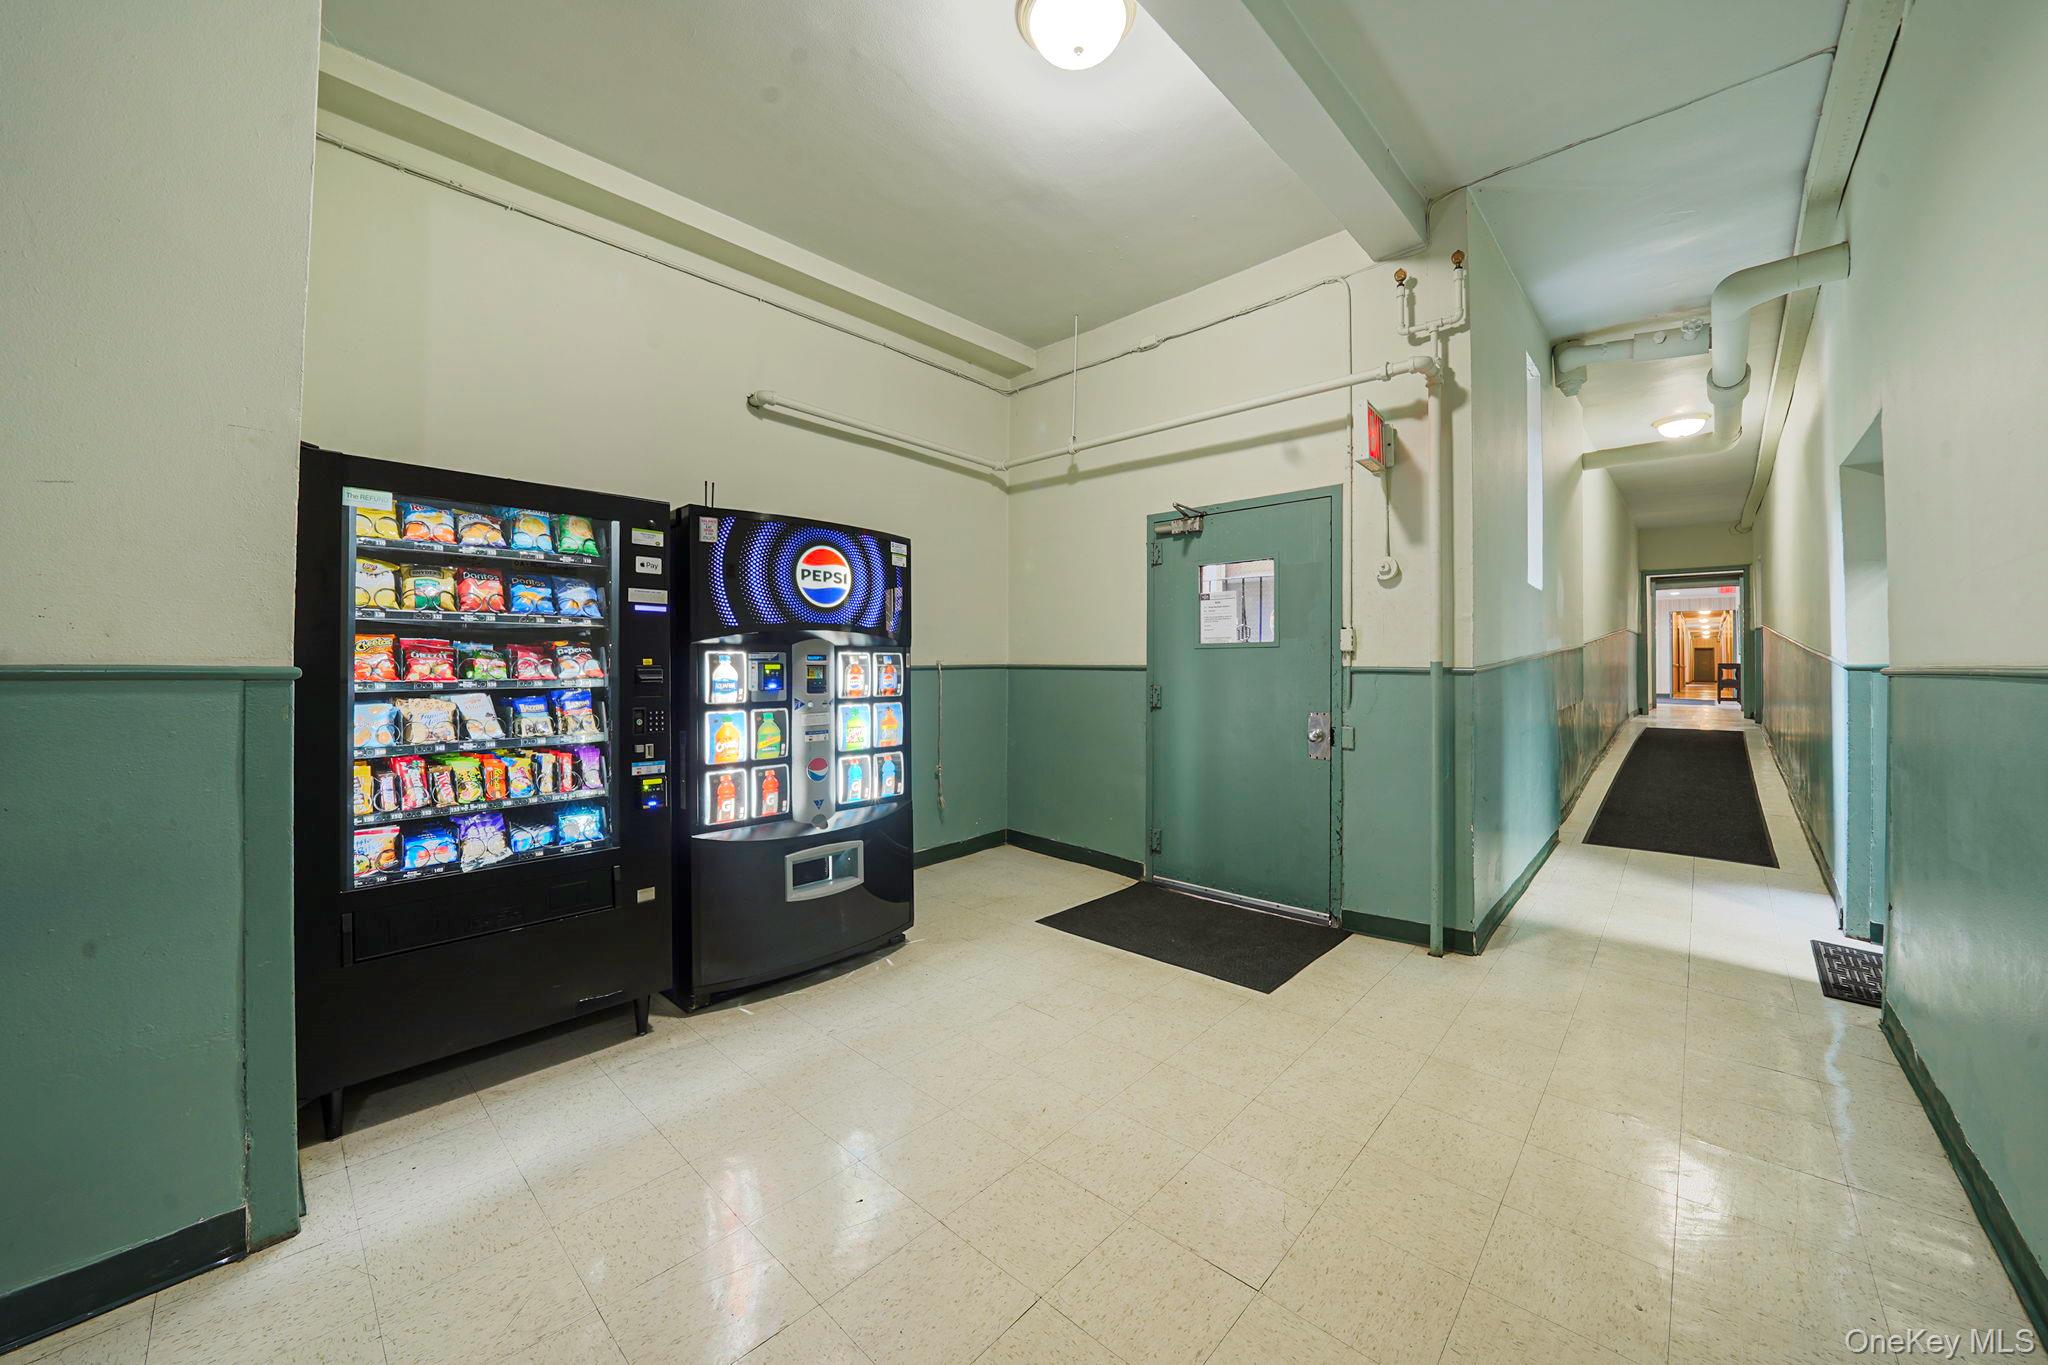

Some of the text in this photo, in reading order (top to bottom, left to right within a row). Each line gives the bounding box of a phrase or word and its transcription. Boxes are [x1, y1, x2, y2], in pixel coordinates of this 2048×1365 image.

[346, 492, 359, 500] The
[646, 562, 659, 570] Pay
[463, 571, 500, 581] Doritos
[801, 568, 847, 585] PEPSI
[511, 577, 546, 588] Doritos
[355, 638, 393, 652] Cheetos
